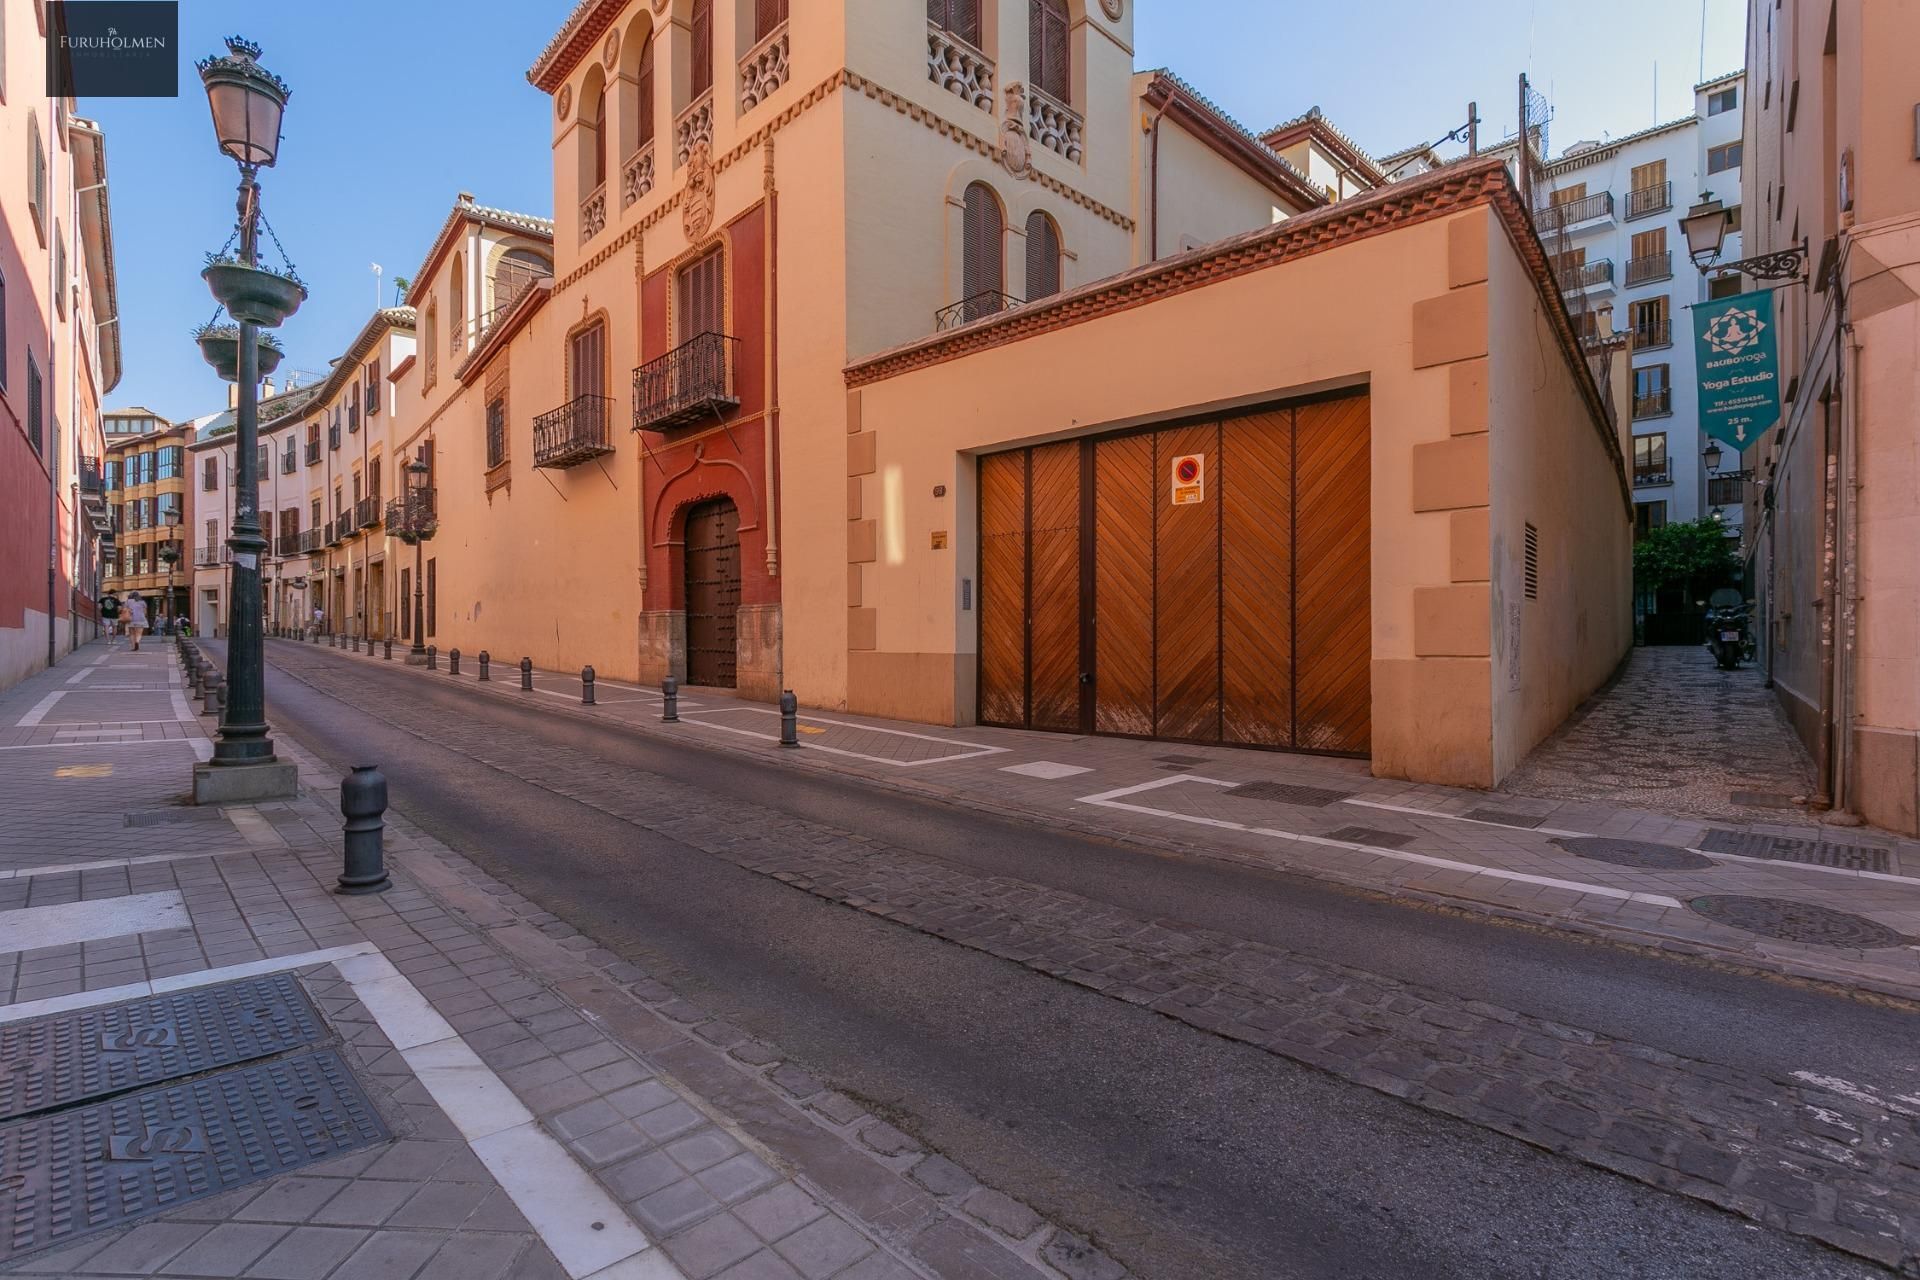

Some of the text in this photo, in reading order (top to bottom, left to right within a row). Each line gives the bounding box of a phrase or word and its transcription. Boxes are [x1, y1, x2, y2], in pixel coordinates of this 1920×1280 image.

[1702, 371, 1774, 390] Yoga Estudio
[1728, 417, 1739, 425] 25
